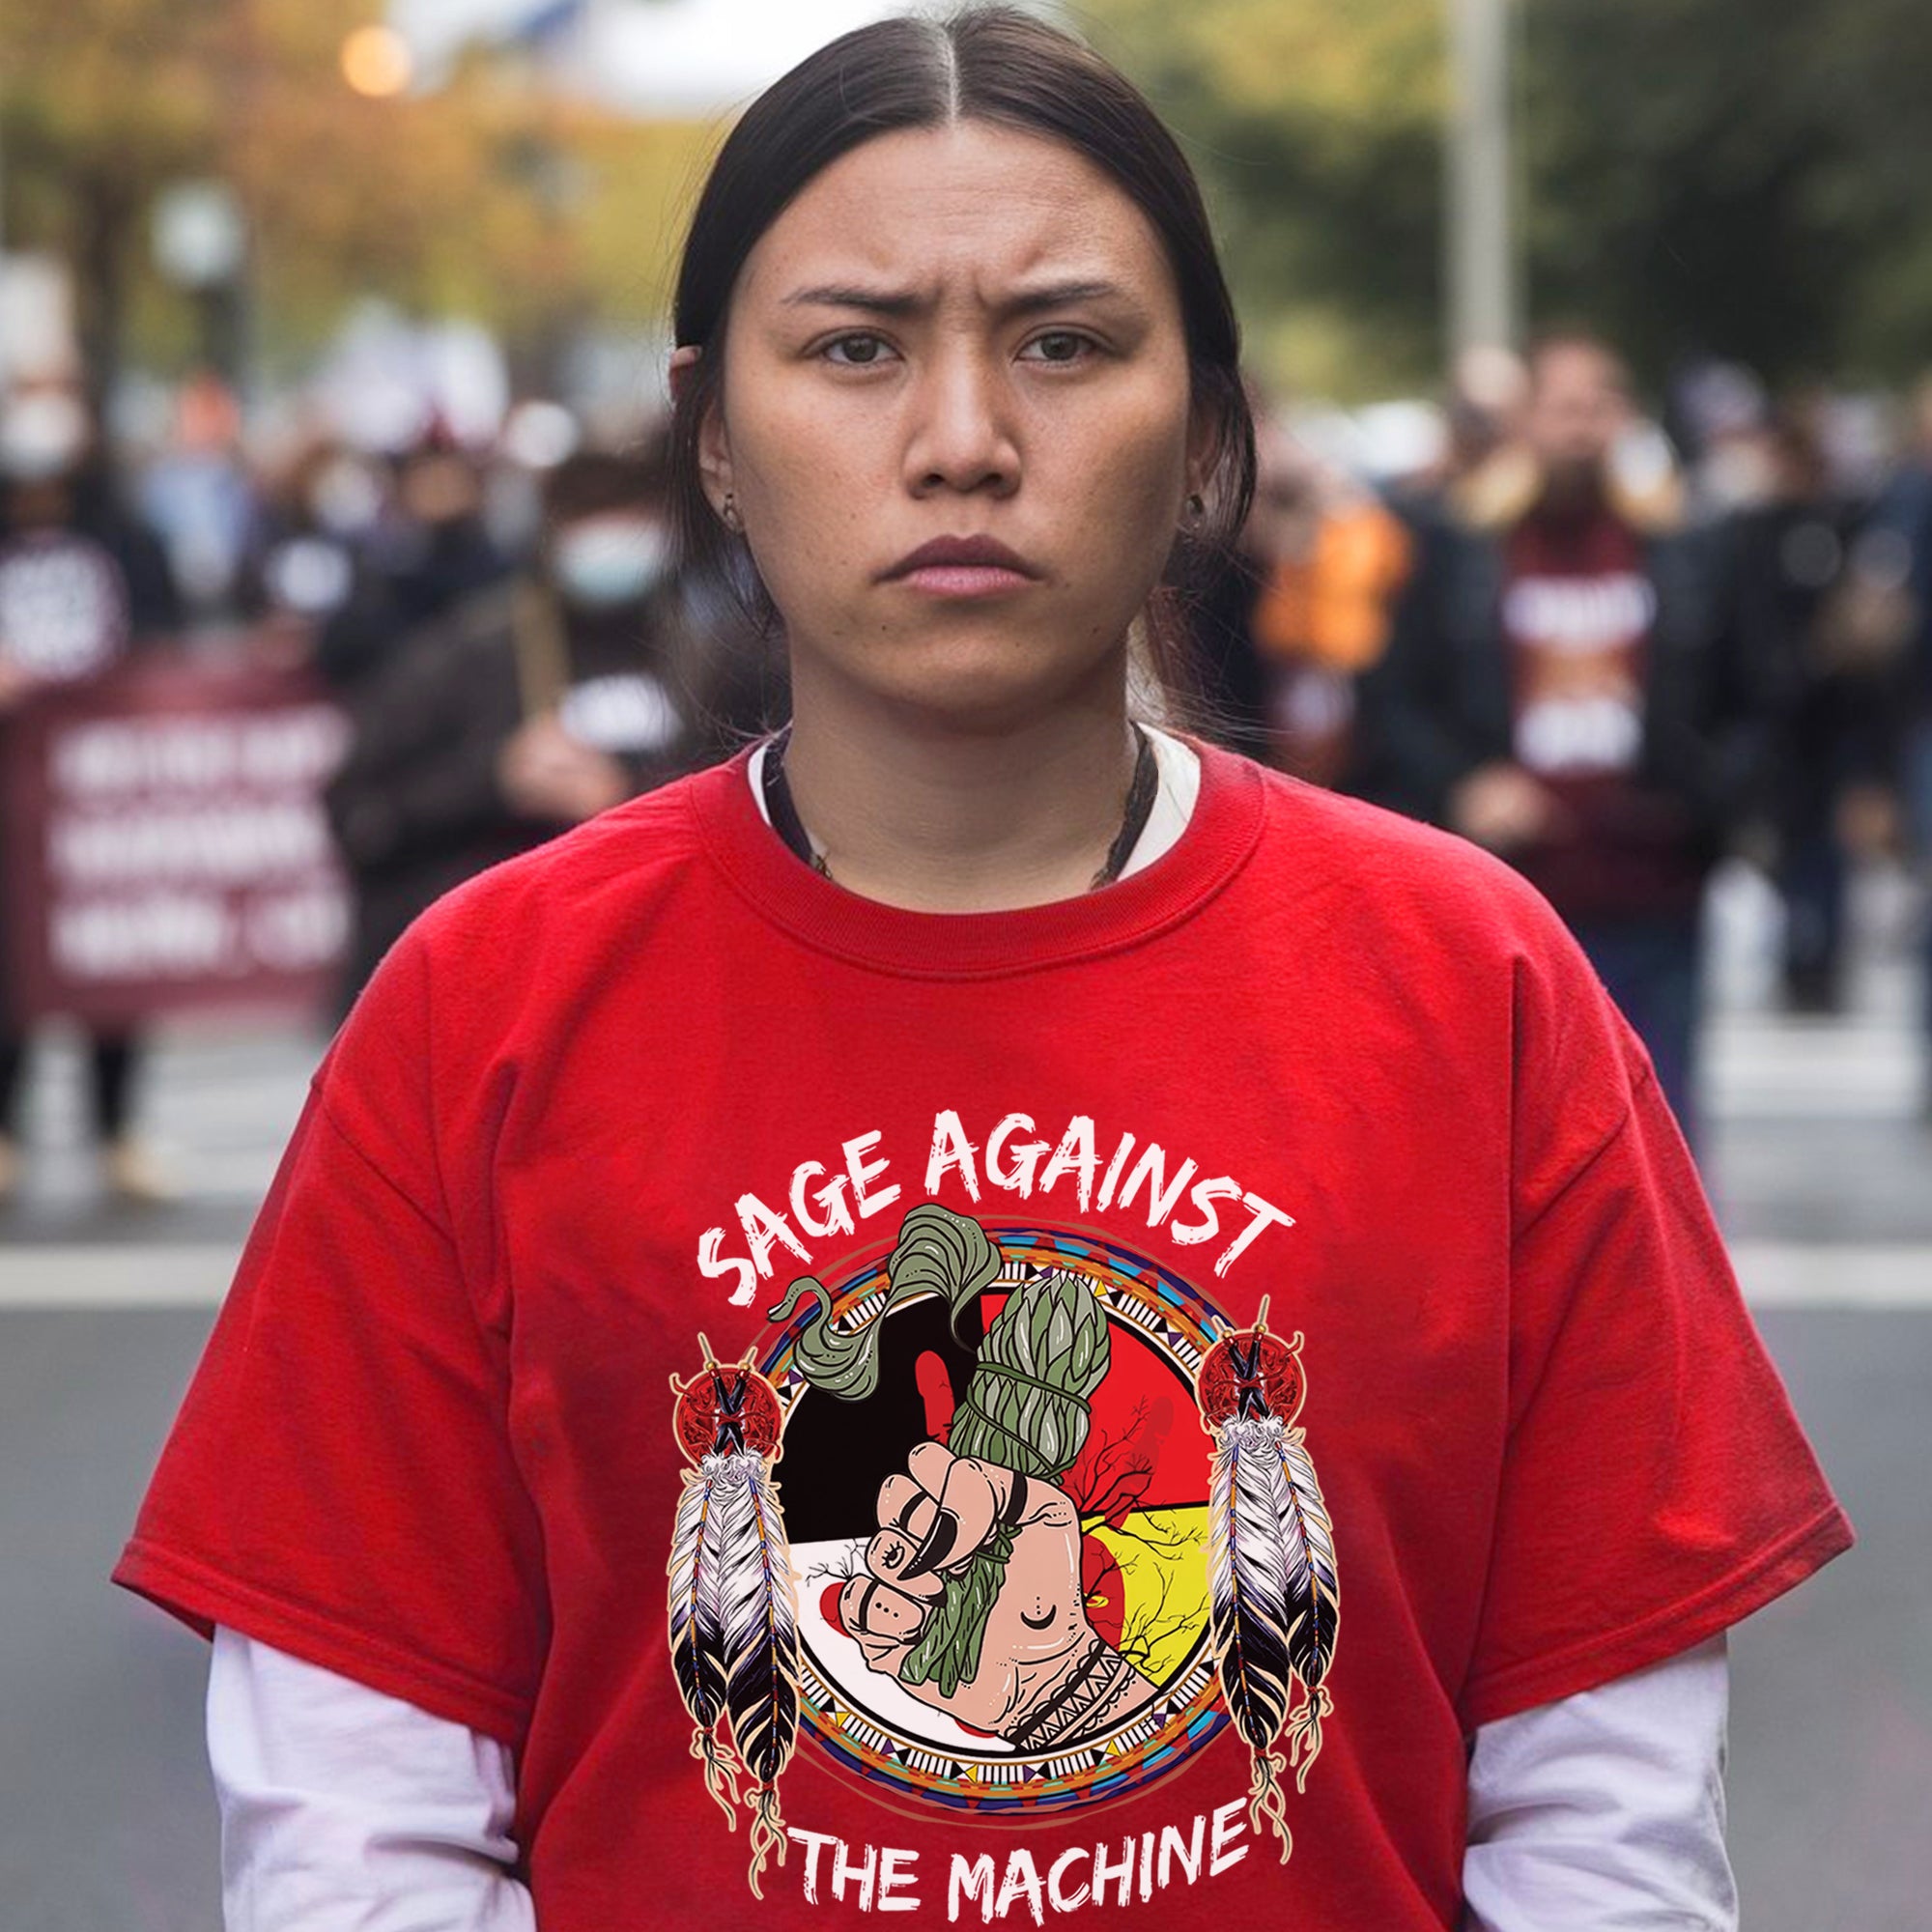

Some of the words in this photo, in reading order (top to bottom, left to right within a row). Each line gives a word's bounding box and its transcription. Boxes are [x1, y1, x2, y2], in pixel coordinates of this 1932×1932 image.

[696, 1129, 900, 1308] SAGE
[924, 1109, 1296, 1279] AGAINST
[786, 1826, 921, 1913] THE
[947, 1797, 1250, 1927] MACHINE
